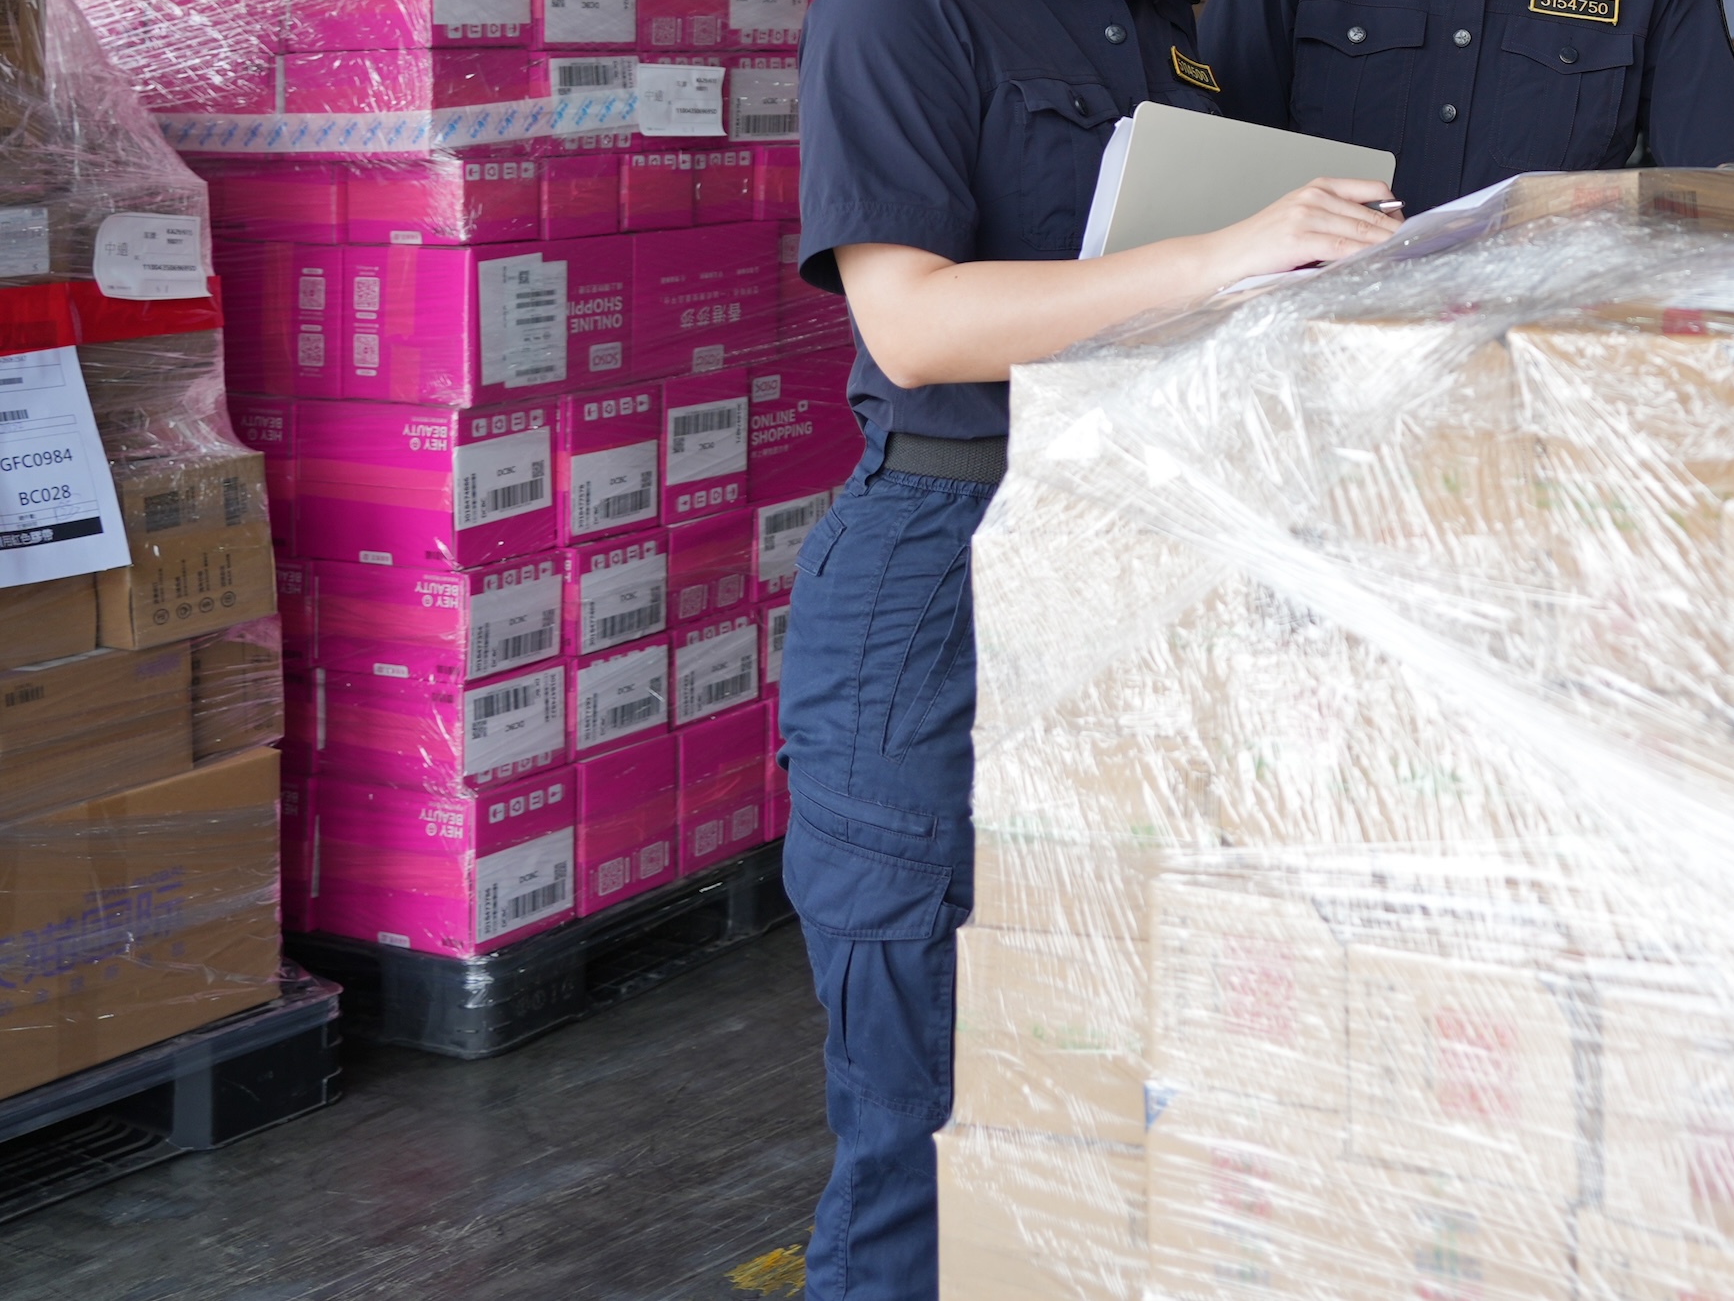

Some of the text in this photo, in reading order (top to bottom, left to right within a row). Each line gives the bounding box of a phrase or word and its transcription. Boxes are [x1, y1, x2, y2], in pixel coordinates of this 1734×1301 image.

[566, 295, 623, 316] SHOPPI
[570, 312, 623, 334] ONLINE
[751, 409, 796, 430] ONLINE
[403, 423, 448, 438] BEAUTY
[751, 421, 813, 446] SHOPPING
[424, 438, 448, 451] HEY
[0, 448, 73, 472] GFC0984
[18, 484, 72, 506] BC028
[414, 580, 459, 597] BEAUTY
[434, 595, 459, 609] HEY
[419, 808, 464, 826] BEAUTY
[440, 824, 464, 839] HEY
